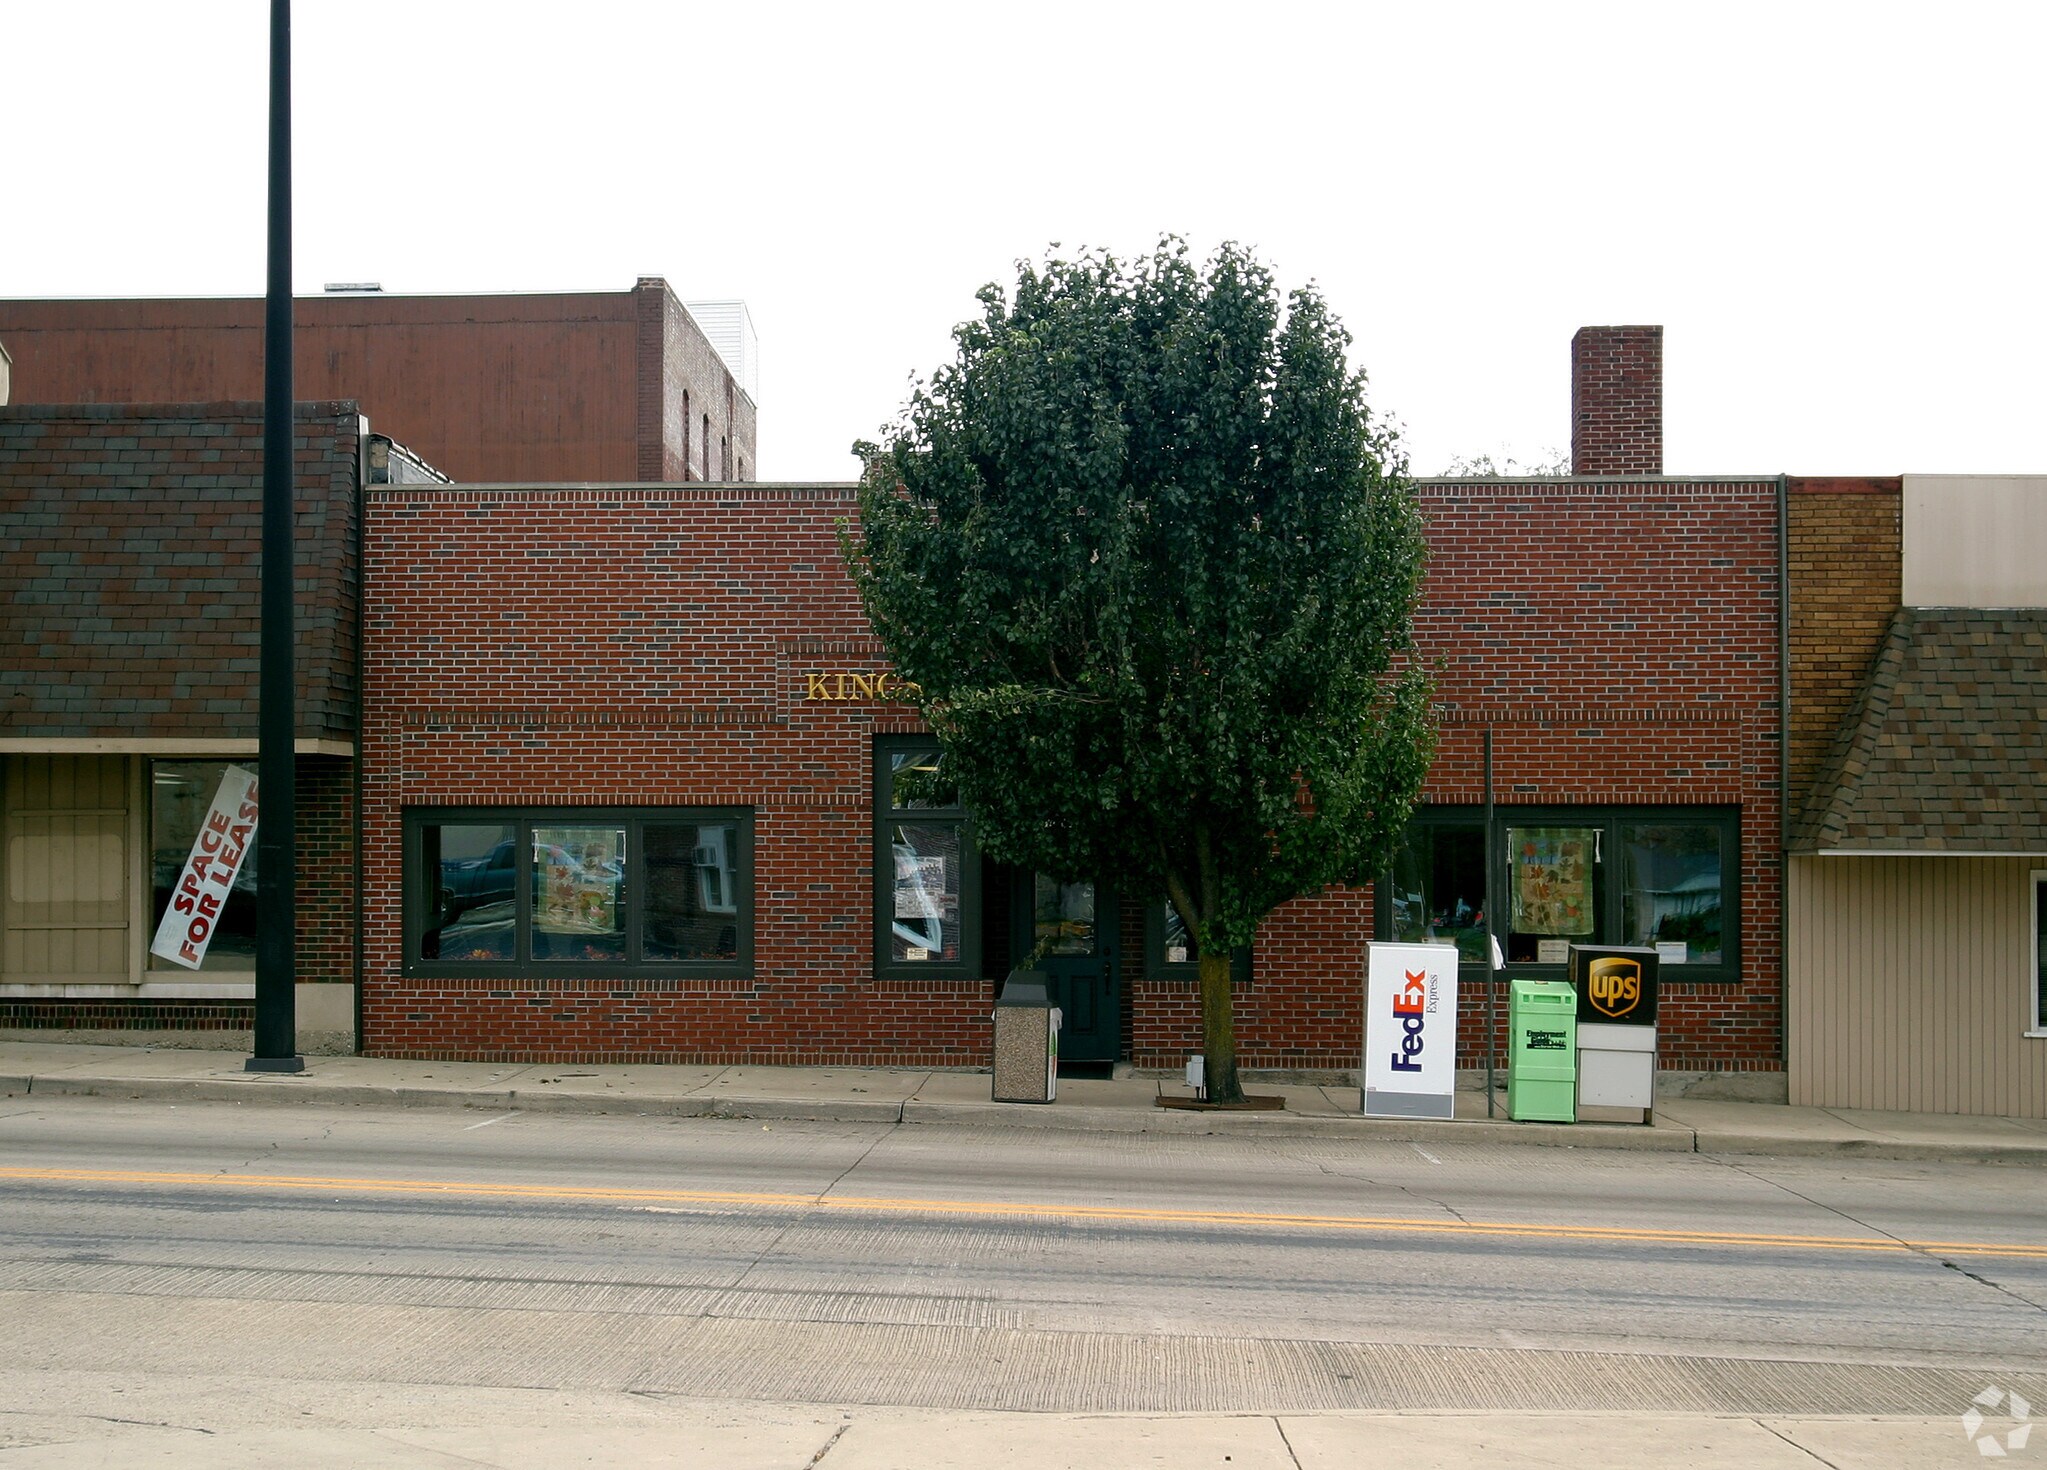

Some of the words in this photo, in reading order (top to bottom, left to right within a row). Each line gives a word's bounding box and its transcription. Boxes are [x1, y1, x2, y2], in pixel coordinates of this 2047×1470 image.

[174, 811, 231, 916] SPACE
[179, 893, 221, 963] FOR
[1391, 968, 1426, 1072] FedEx
[1426, 974, 1439, 1014] Express
[1593, 975, 1636, 1007] ups
